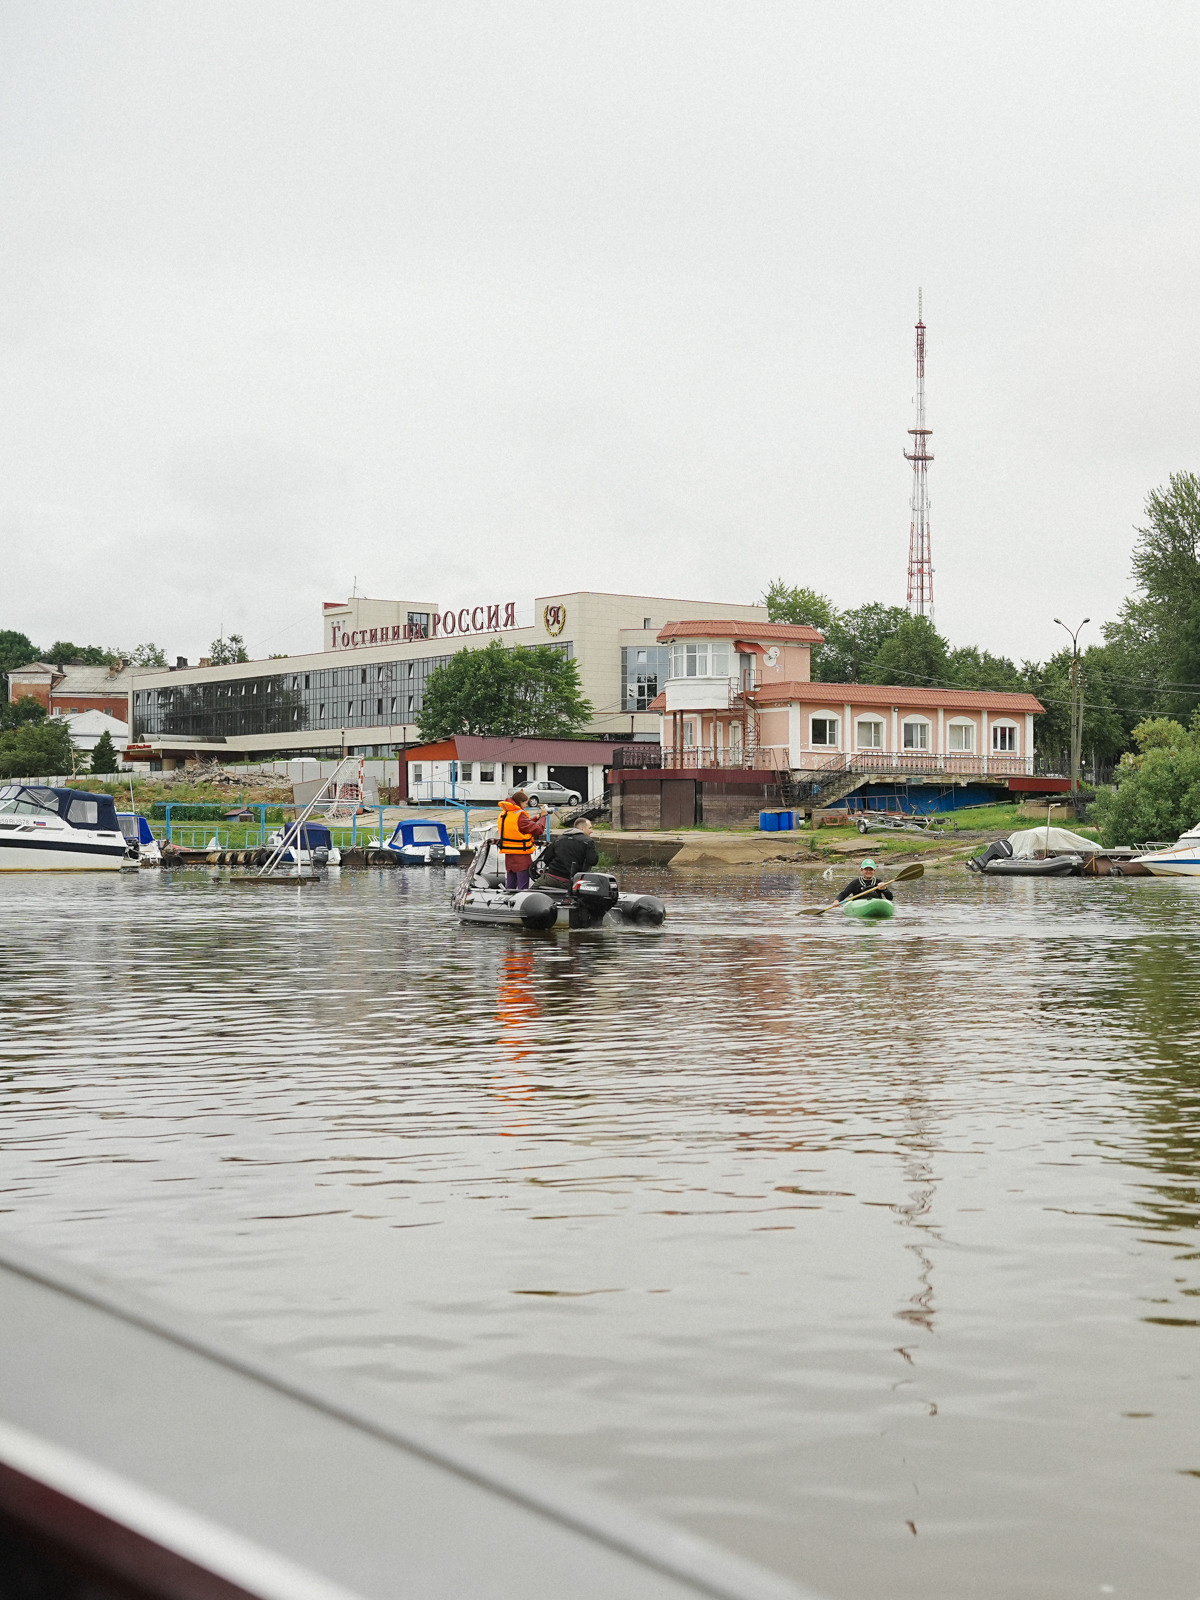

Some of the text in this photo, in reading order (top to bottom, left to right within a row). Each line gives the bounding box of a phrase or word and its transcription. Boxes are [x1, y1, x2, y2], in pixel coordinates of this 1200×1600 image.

[331, 601, 516, 647] Гостиница РОССИЯ
[0, 818, 30, 826] 59RUS78
